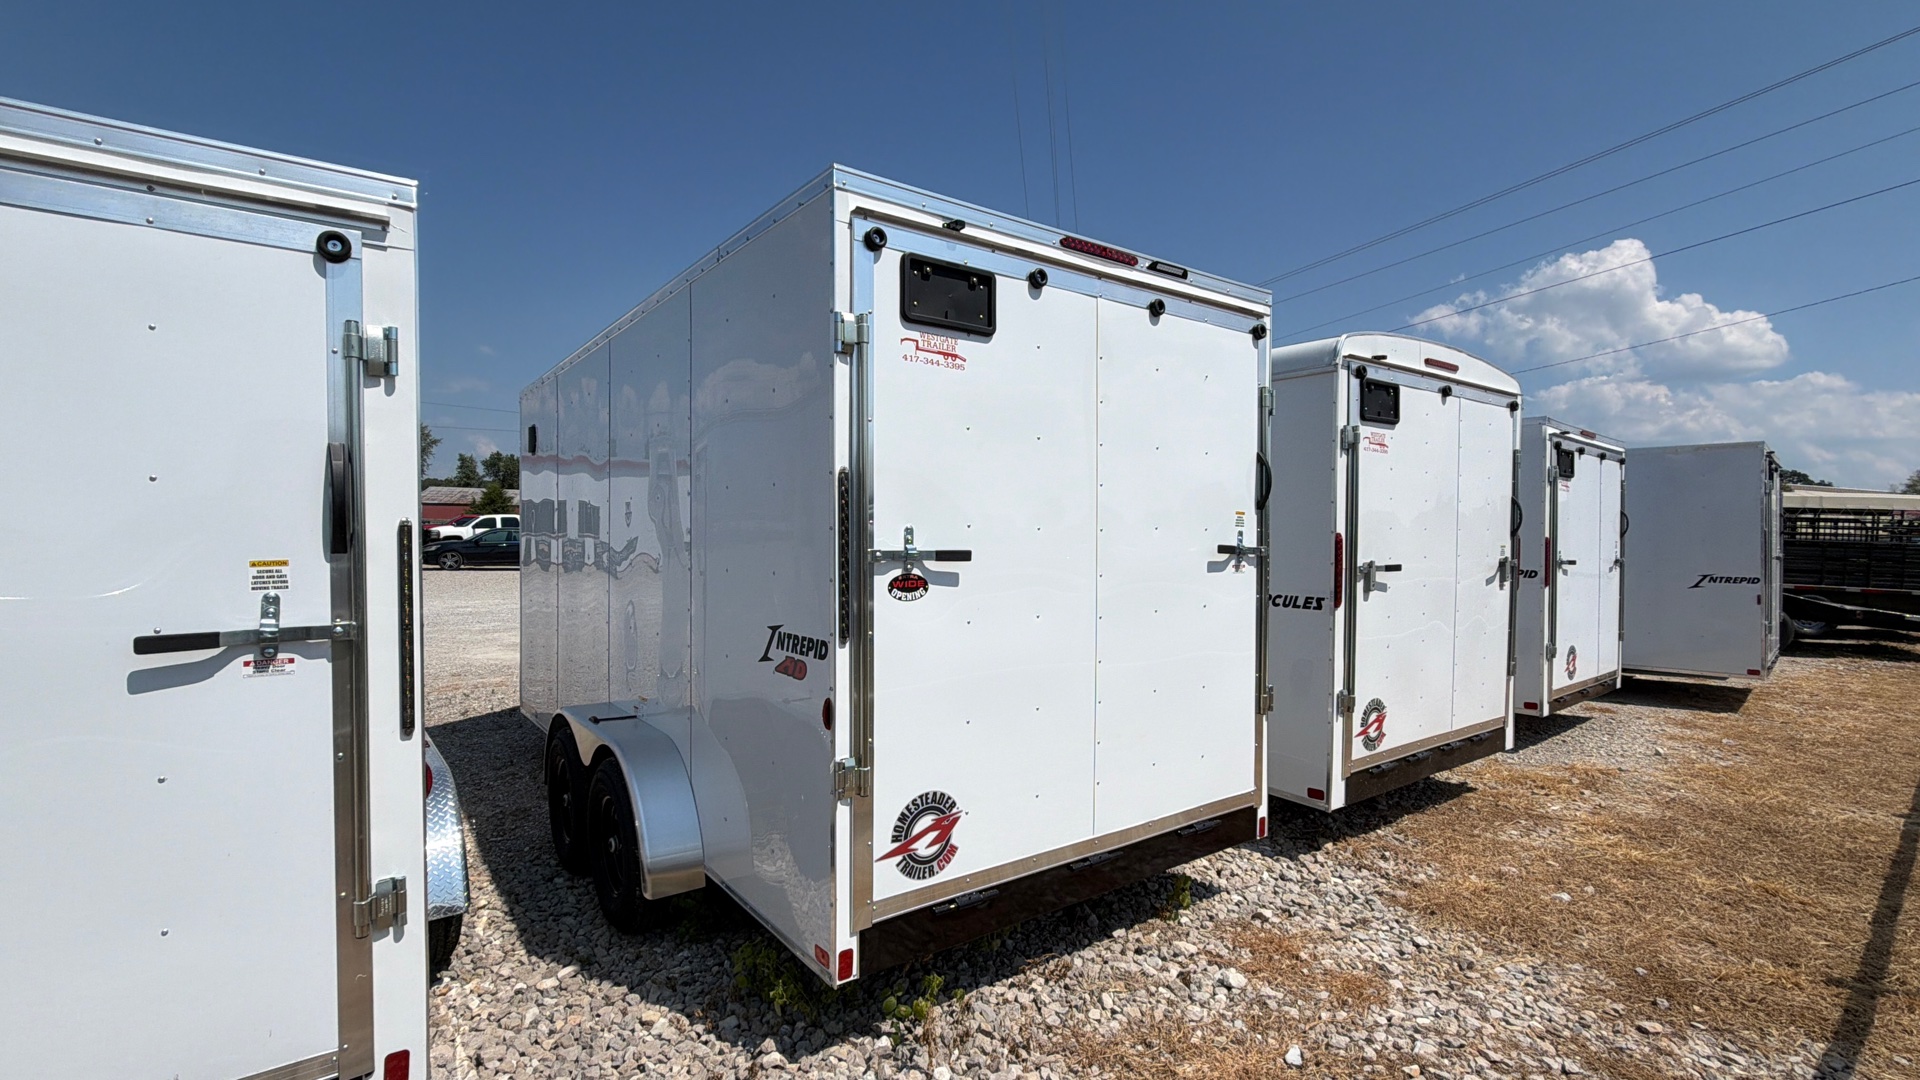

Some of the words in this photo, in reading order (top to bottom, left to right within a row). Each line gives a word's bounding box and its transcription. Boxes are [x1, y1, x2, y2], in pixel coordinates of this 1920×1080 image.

[919, 331, 959, 346] WESTGATE
[921, 340, 956, 352] TRAILER
[902, 354, 966, 371] 417-344-3395
[892, 580, 925, 588] WIDE
[1687, 573, 1761, 589] INTREPID
[891, 588, 925, 600] OPENING
[758, 624, 829, 662] INTREPID
[256, 658, 289, 666] DANGER
[891, 791, 957, 843] HOMESTEADER
